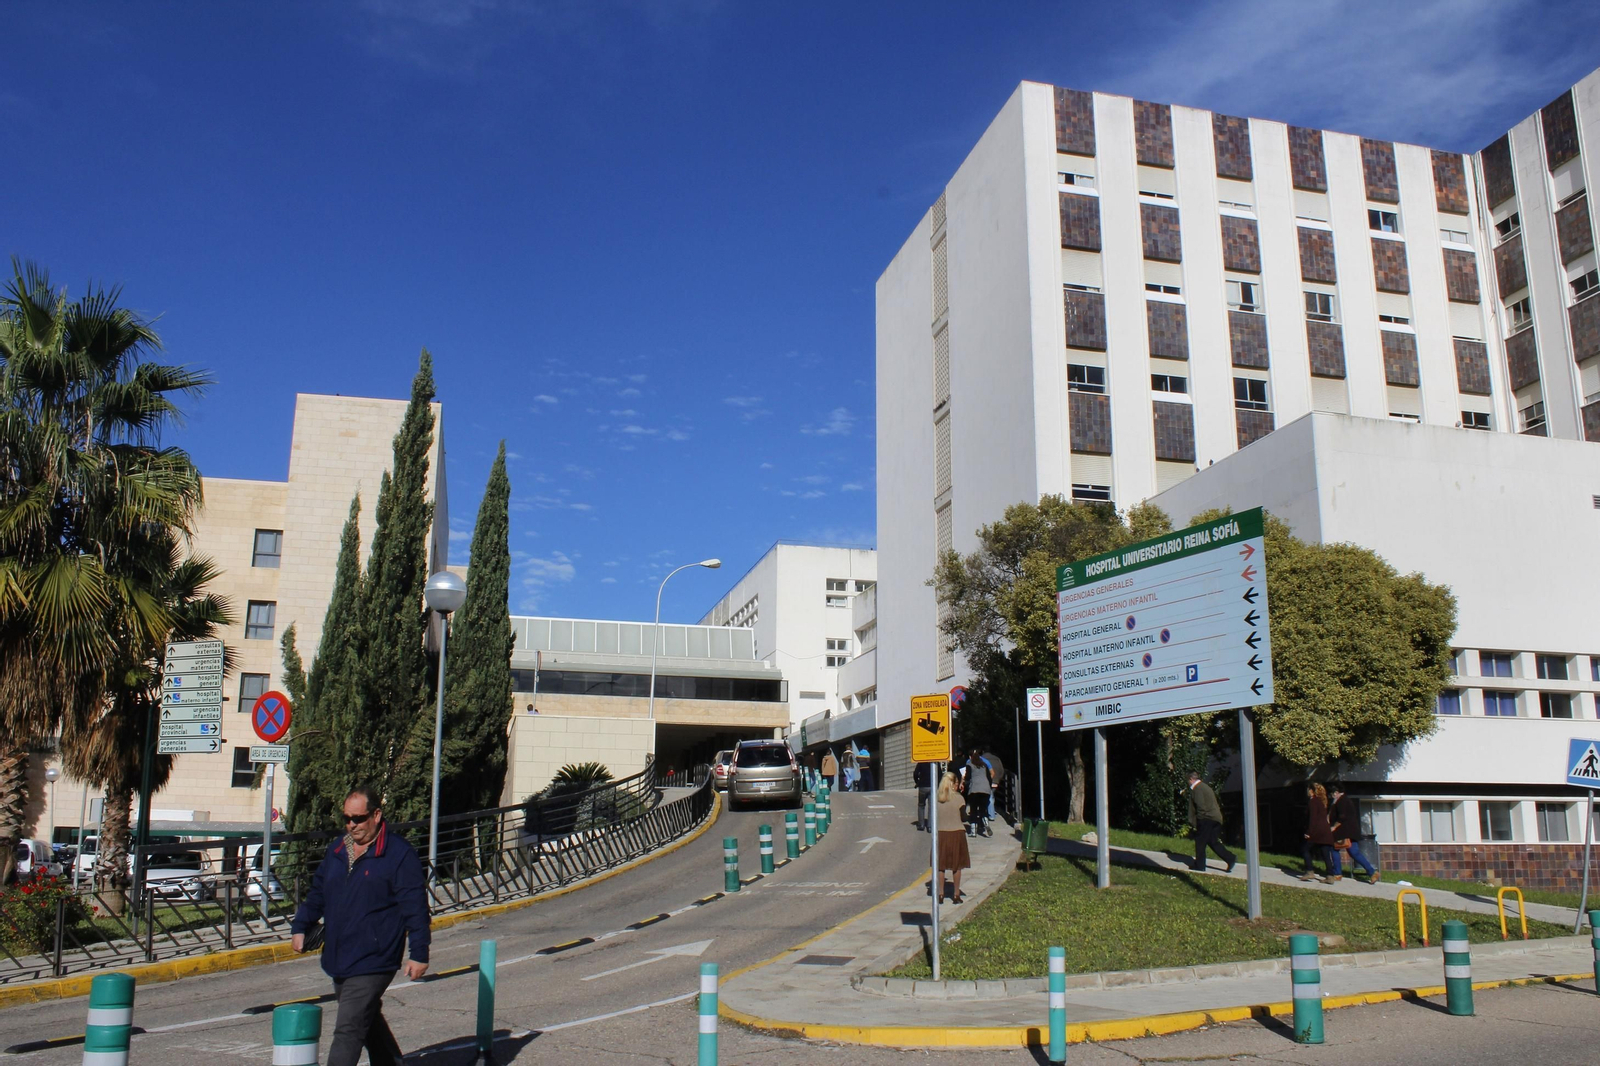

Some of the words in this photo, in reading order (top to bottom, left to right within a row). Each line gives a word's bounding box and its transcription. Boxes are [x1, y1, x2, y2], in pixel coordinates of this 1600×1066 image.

[1085, 556, 1121, 577] HOSPITAL
[1122, 538, 1182, 566] UNIVERSITARIO
[1184, 530, 1211, 549] REINA
[1212, 519, 1240, 541] SOFÍA
[1061, 589, 1095, 604] URGENCIAS
[1096, 578, 1134, 595] GENERALES
[1062, 608, 1096, 623] URGENCIAS
[1097, 600, 1128, 613] MATERNO
[1129, 592, 1159, 606] INFANTIL
[1062, 628, 1091, 642] HOSPITAL
[1092, 622, 1122, 634] GENERAL
[1063, 647, 1092, 661] HOSPITAL
[1093, 641, 1125, 655] MATERNO
[1125, 635, 1156, 648] INFANTIL
[1063, 667, 1100, 680] CONSULTAS
[1100, 659, 1134, 673] EXTERNAS
[1188, 667, 1196, 680] P
[1064, 683, 1112, 699] APARCAMIENTO
[1112, 678, 1144, 691] GENERAL
[1145, 677, 1149, 685] 1
[1095, 703, 1122, 716] IMIBIC
